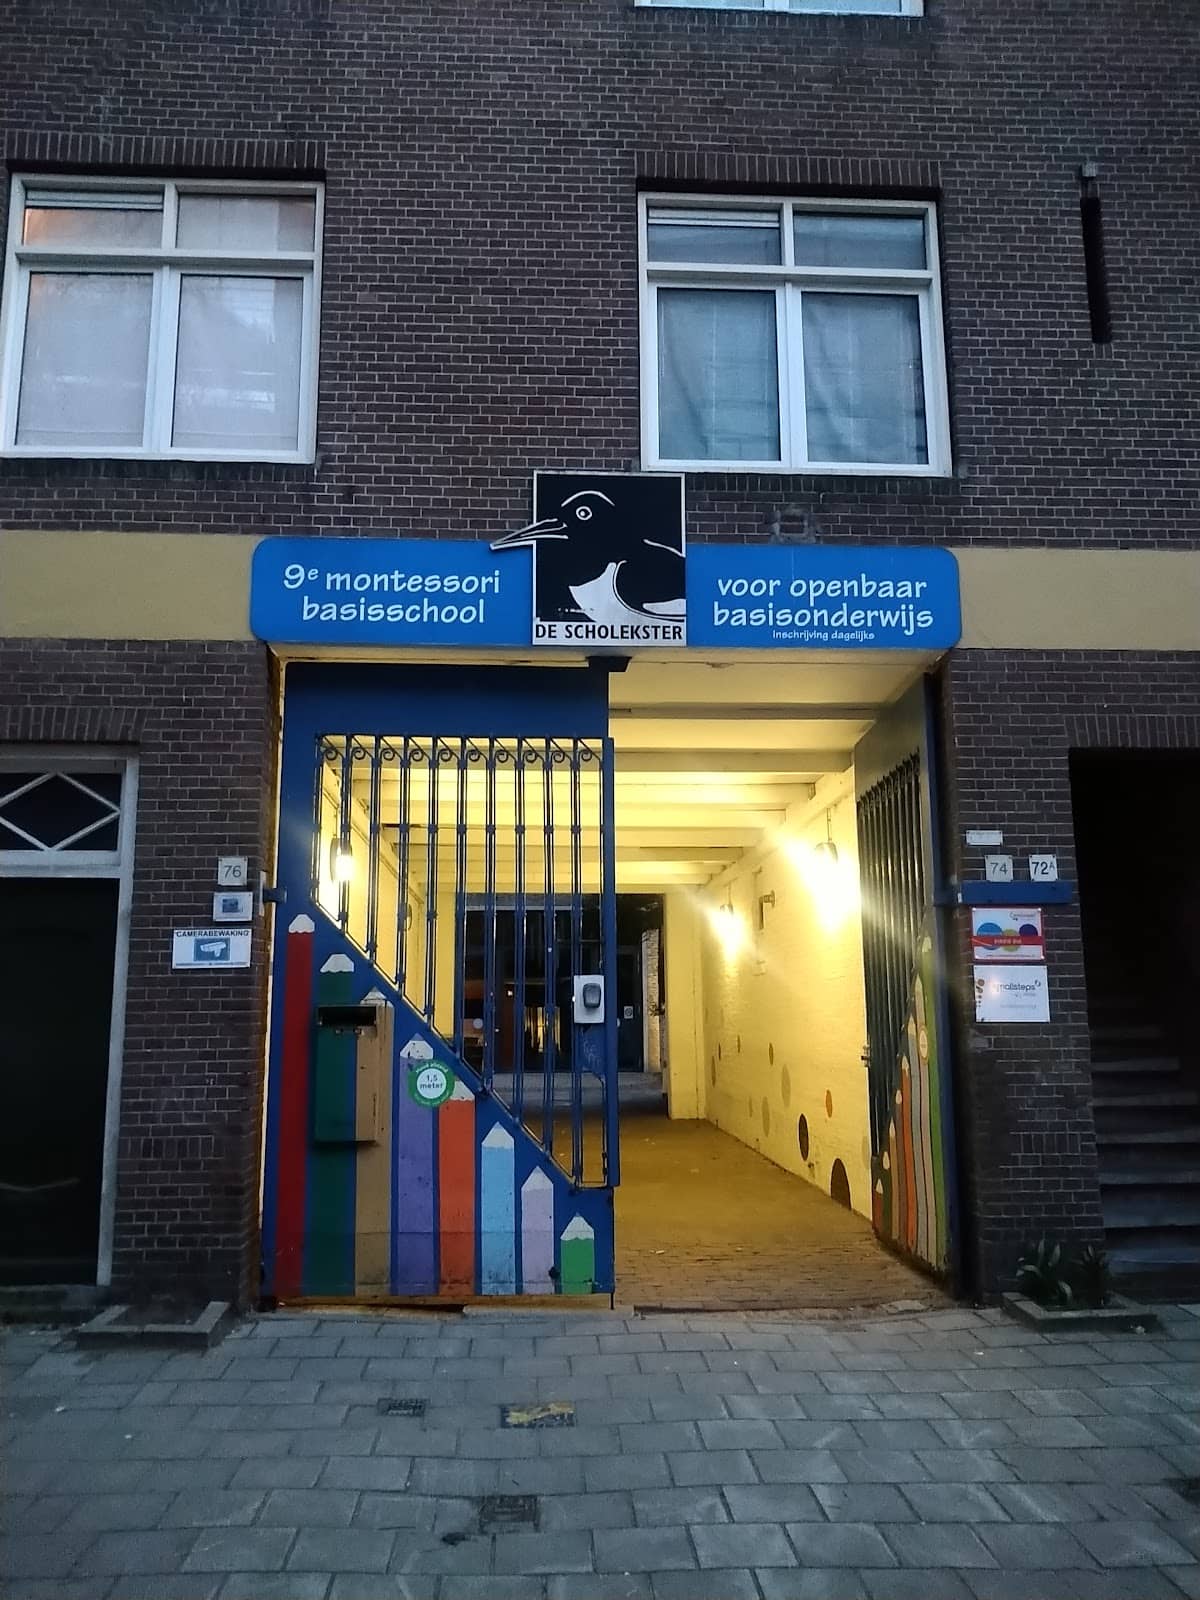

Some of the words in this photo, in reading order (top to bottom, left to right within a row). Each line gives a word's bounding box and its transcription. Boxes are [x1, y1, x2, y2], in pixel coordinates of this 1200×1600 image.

[283, 564, 319, 590] 9e
[325, 570, 500, 594] montessori
[717, 578, 781, 598] voor
[789, 573, 927, 607] openbaar
[302, 595, 485, 624] basisschool
[713, 601, 934, 636] basisonderwijs
[535, 624, 557, 639] DE
[564, 624, 683, 640] SCHOLEKSTER
[224, 866, 242, 878] 76
[990, 862, 1008, 875] 74
[1031, 861, 1055, 875] 72A
